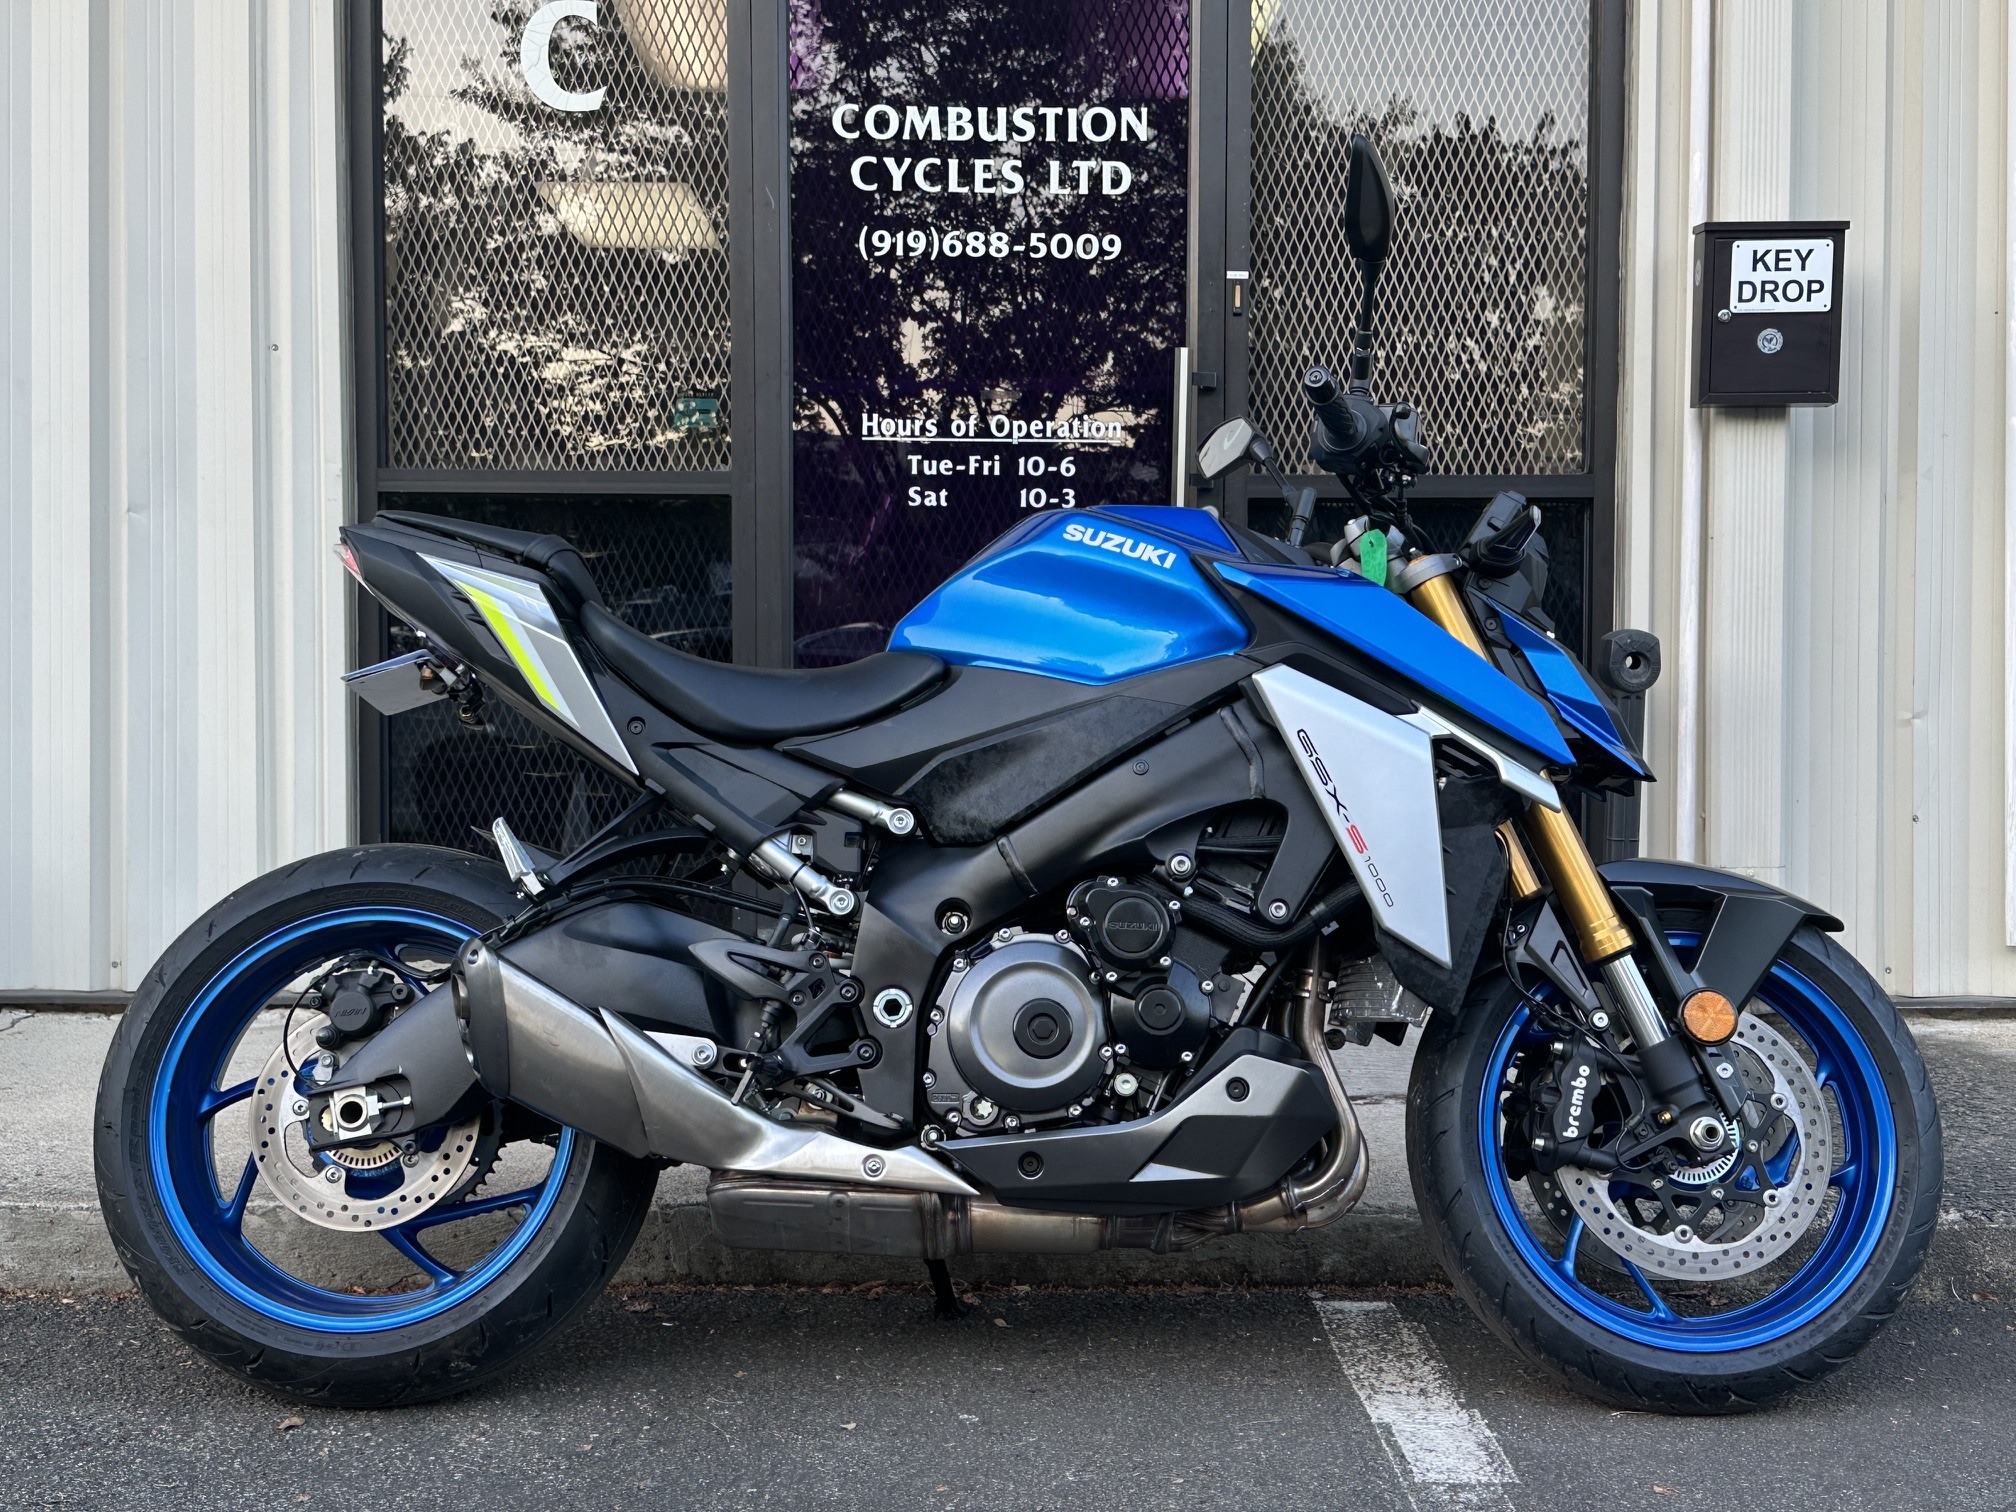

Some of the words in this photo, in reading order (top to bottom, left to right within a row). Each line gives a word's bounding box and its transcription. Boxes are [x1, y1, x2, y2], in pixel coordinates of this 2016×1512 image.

[520, 0, 608, 112] C
[832, 103, 1148, 142] COMBUSTION
[850, 156, 1025, 195] CYCLES
[1049, 159, 1132, 196] LTD
[858, 226, 1122, 260] (919)688-5009
[1752, 248, 1815, 272] KEY
[1737, 279, 1825, 303] DROP
[862, 414, 937, 438] Hours
[950, 415, 977, 437] of
[990, 416, 1122, 443] Operation
[907, 454, 1000, 476] Tue-Fri
[1018, 456, 1076, 477] 10-6
[908, 486, 948, 507] Sat
[1019, 488, 1076, 508] 10-3
[1062, 524, 1177, 569] SUZUKI
[1108, 921, 1159, 931] SUZUKI
[1562, 1065, 1591, 1138] brembo
